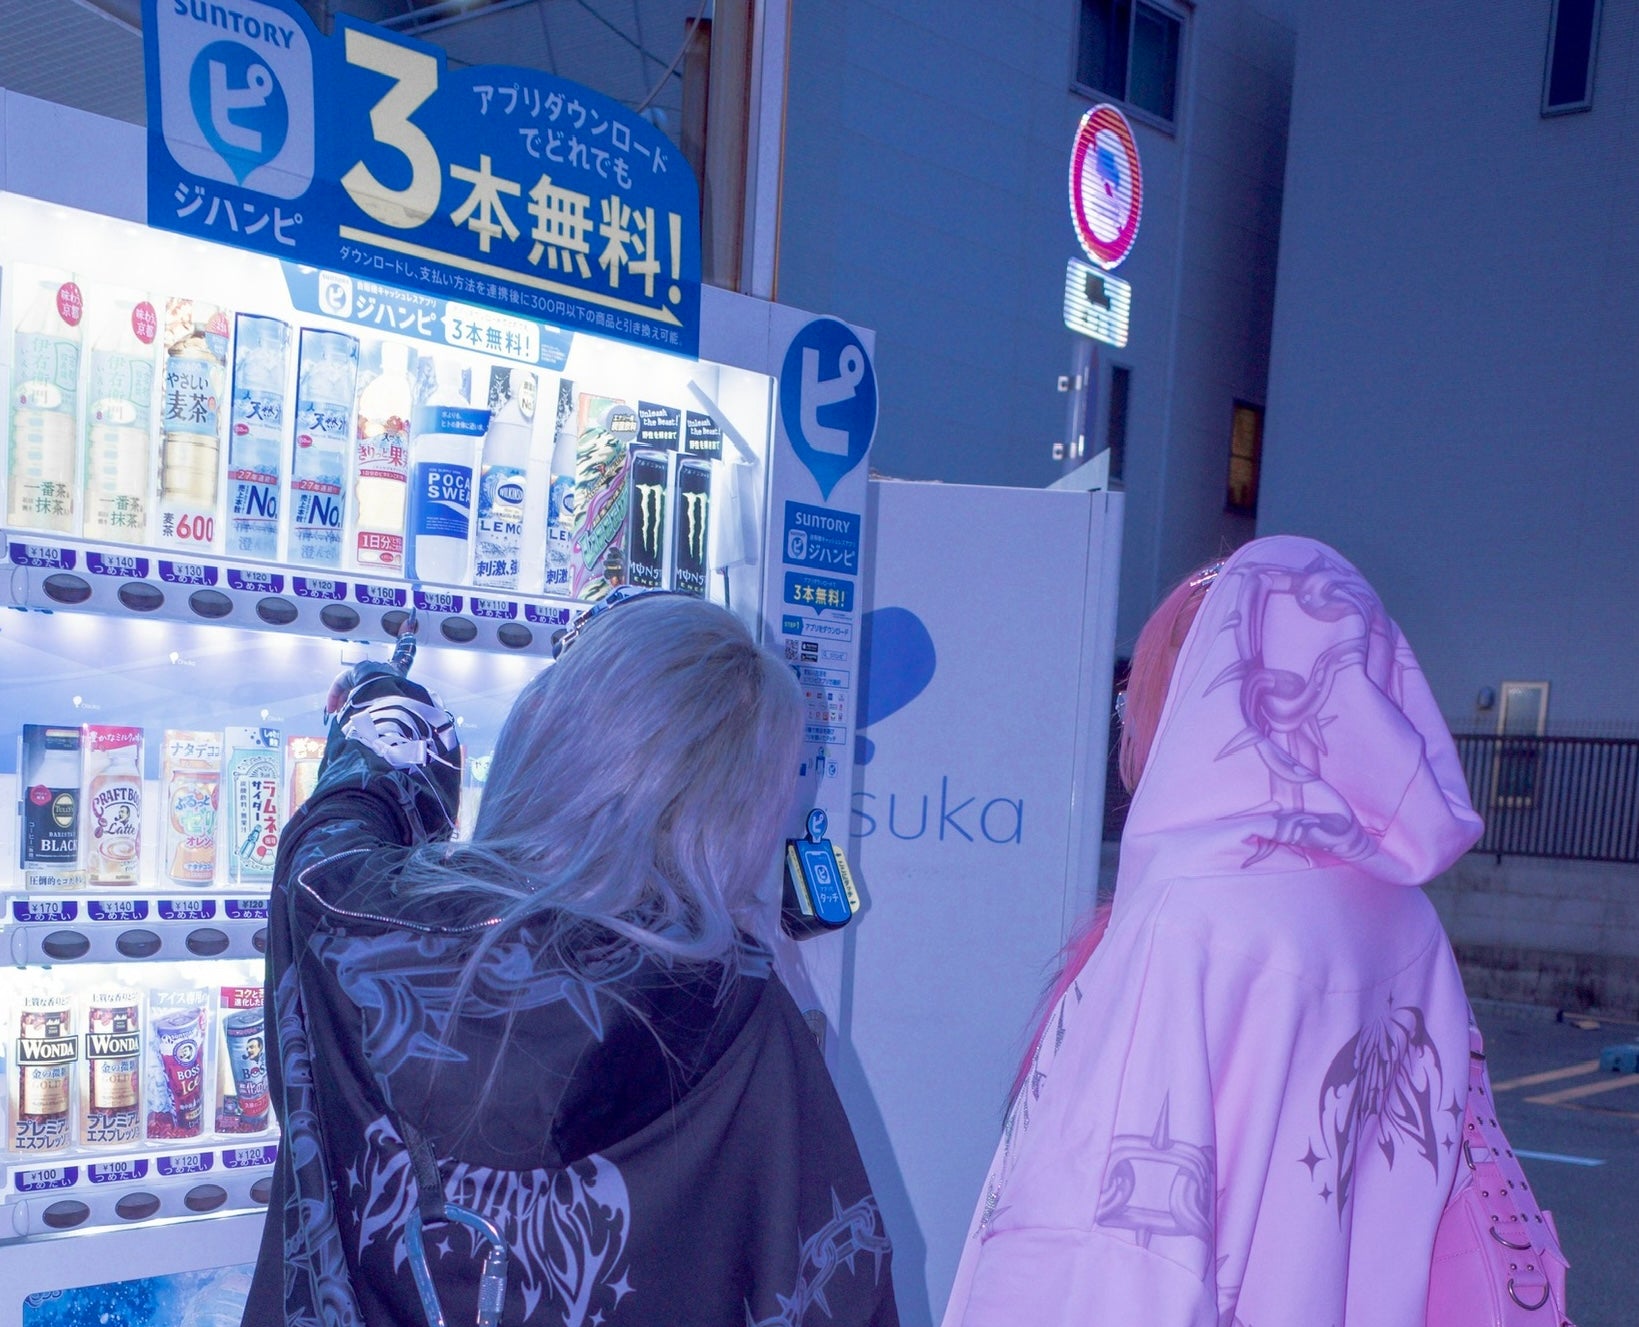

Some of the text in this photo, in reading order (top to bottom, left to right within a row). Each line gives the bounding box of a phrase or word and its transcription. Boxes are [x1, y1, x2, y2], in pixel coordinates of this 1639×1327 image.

[174, 0, 294, 49] SUNTORY
[472, 84, 668, 174] アプリダウンロード
[518, 127, 632, 189] でどれでも
[174, 181, 303, 246] ジハンピ
[356, 295, 436, 336] ジハンピ
[452, 319, 529, 357] 3本無料!
[167, 372, 208, 390] やさしい
[166, 390, 208, 423] 麦茶
[795, 512, 850, 533] SUNTORY
[809, 544, 855, 566] ジハンピ
[17, 556, 70, 569] つめたい
[94, 564, 142, 577] つめたい
[166, 573, 212, 586] つめたい
[234, 581, 278, 593] つめたい
[299, 588, 341, 600] つめたい
[794, 584, 845, 607] 3本無料!
[361, 596, 402, 607] つめたい
[419, 602, 459, 613] つめたい
[477, 609, 513, 620] つめたい
[530, 614, 566, 625] つめたい
[252, 780, 262, 821] サイダー
[263, 781, 277, 833] ラムネ
[850, 776, 1023, 844] suka
[104, 823, 136, 835] Latte
[22, 911, 71, 921] つめたい
[95, 911, 143, 921] つめたい
[164, 910, 211, 920] つめたい
[21, 1038, 75, 1060] WONDA
[91, 1034, 139, 1055] WONDA
[177, 1063, 200, 1080] BOSS
[175, 1155, 199, 1166] ¥120
[238, 1149, 261, 1160] ¥120
[103, 1162, 127, 1173] ¥100
[229, 1156, 272, 1168] つめたい
[31, 1169, 57, 1180] ¥100
[164, 1163, 208, 1175] つめたい
[95, 1170, 142, 1183] つめたい
[24, 1178, 72, 1191] つめたい
